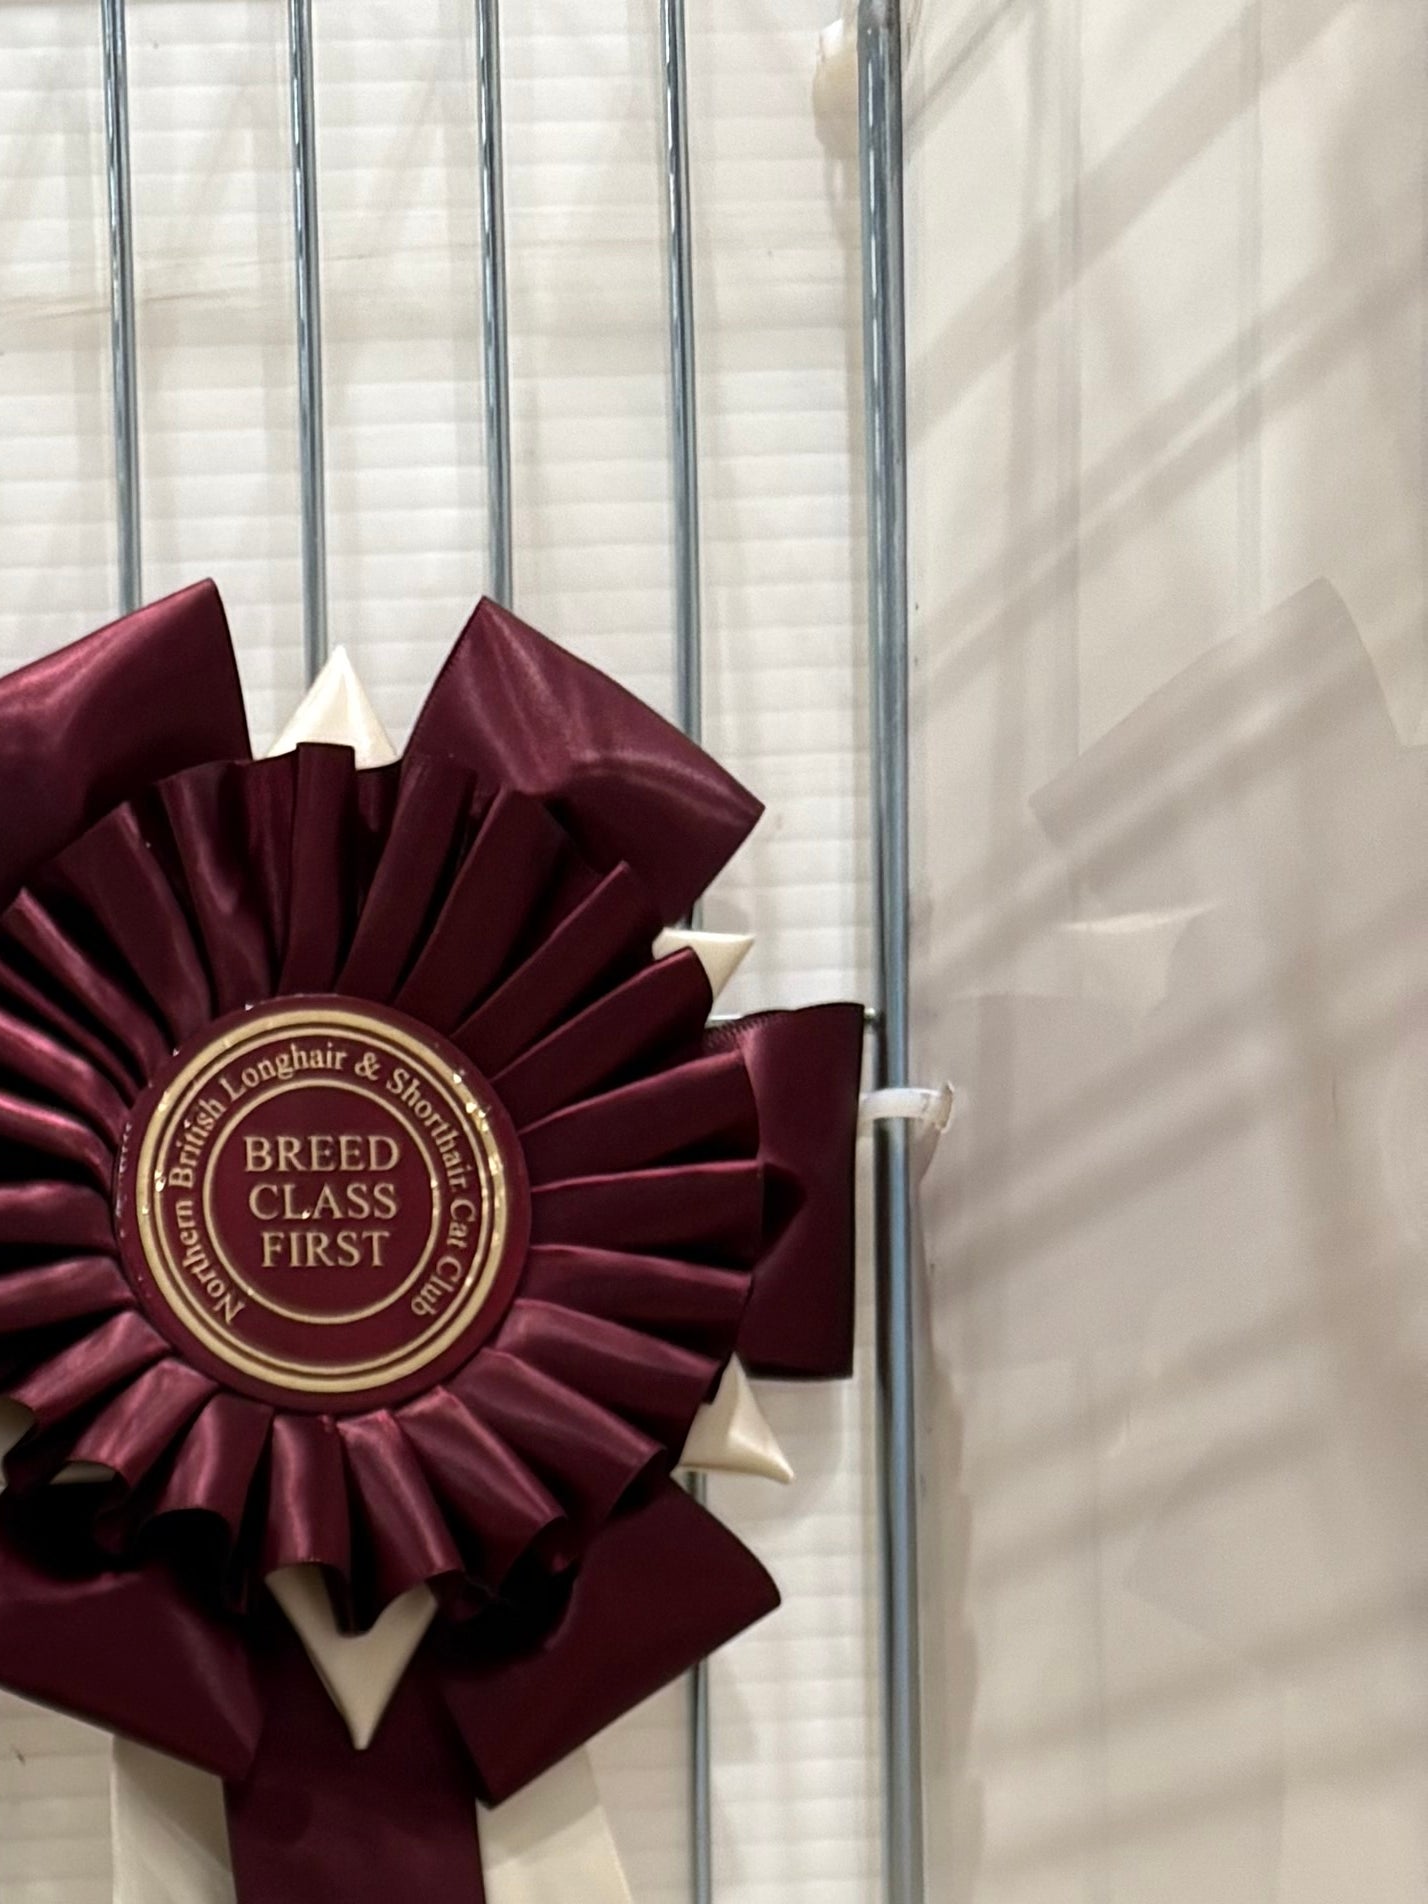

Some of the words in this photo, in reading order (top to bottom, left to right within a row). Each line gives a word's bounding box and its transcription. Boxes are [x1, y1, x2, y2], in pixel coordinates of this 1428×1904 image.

[220, 1042, 349, 1102] Longhair
[353, 1050, 381, 1082] &
[169, 1096, 227, 1190] British
[243, 1134, 401, 1174] BREED
[385, 1067, 469, 1191] Shorthair
[248, 1183, 399, 1221] CLASS
[447, 1198, 477, 1251] Cat
[174, 1198, 246, 1325] Northern
[260, 1230, 391, 1268] FIRST
[410, 1253, 464, 1318] Club
